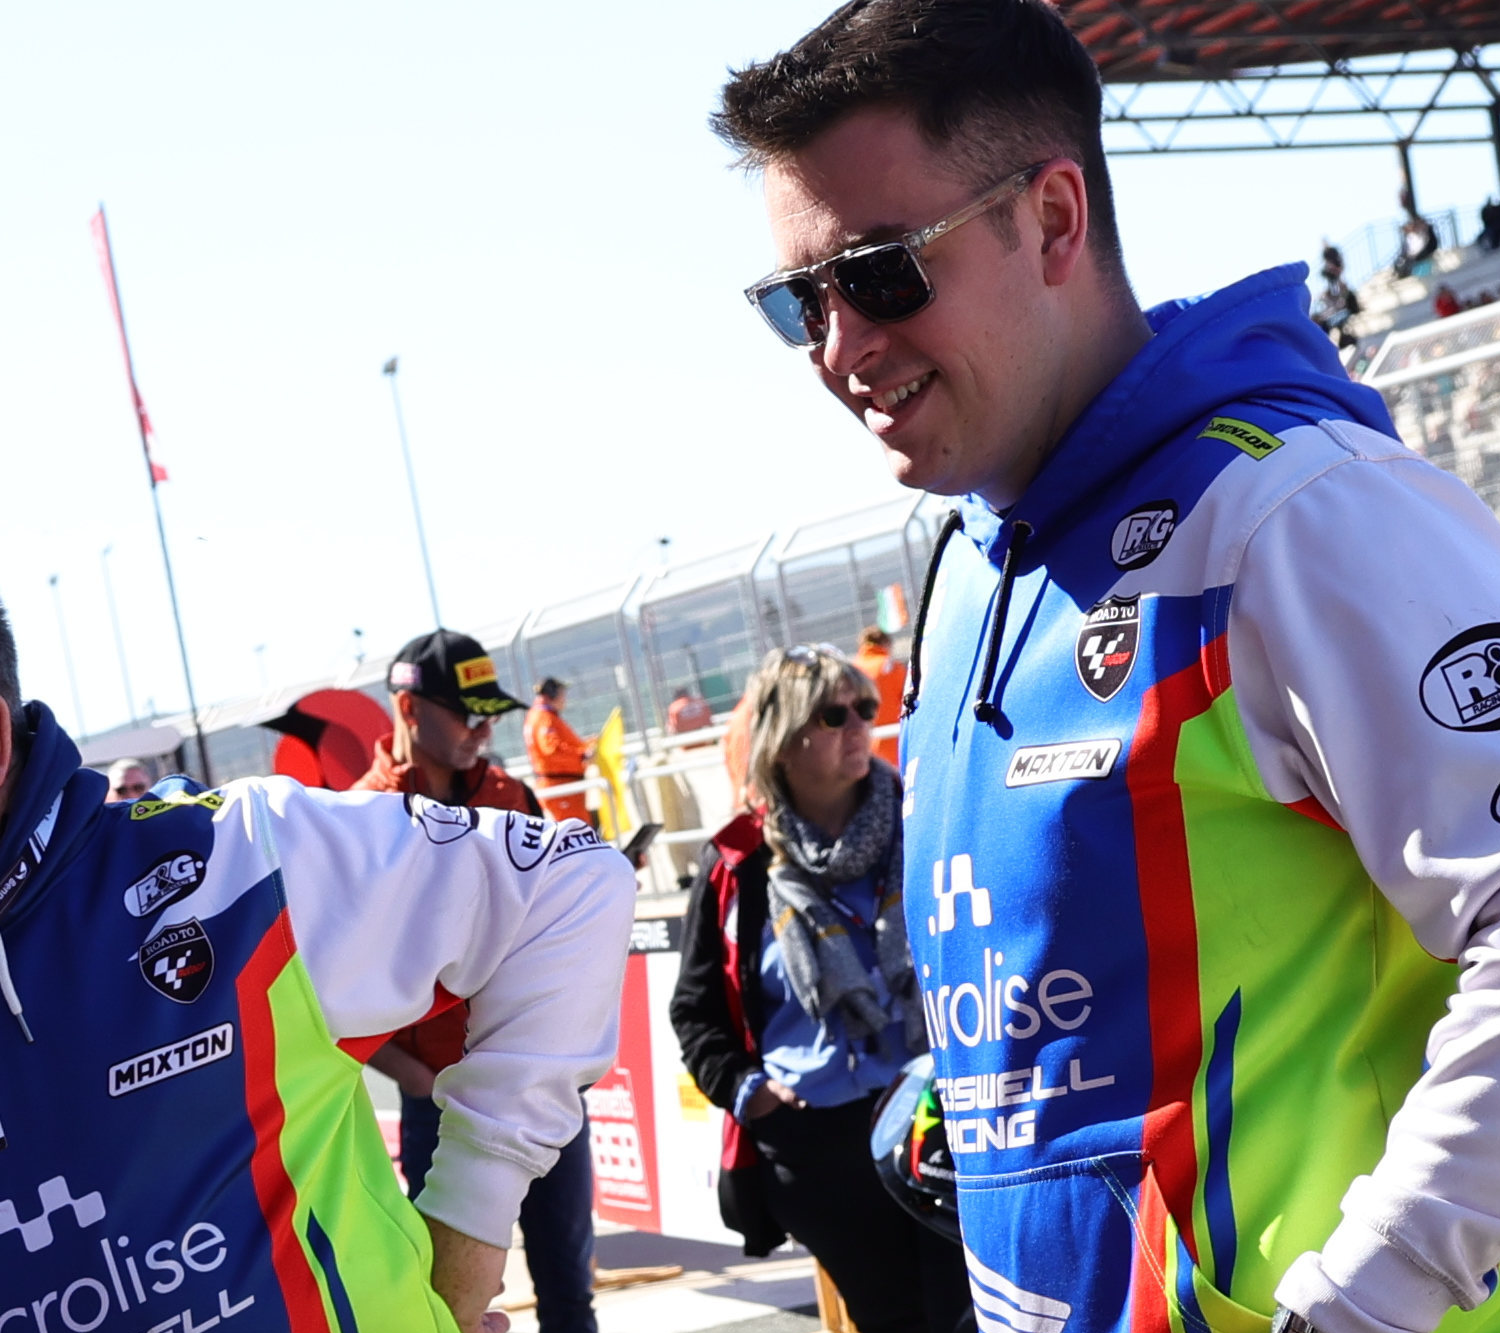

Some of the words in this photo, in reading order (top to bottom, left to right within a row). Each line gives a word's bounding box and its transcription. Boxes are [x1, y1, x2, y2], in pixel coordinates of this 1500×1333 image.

[1213, 424, 1273, 450] DUNLOP
[1120, 605, 1136, 618] TO
[1011, 747, 1111, 780] MAXTON
[177, 926, 195, 939] TO
[115, 1028, 228, 1091] MAXTON
